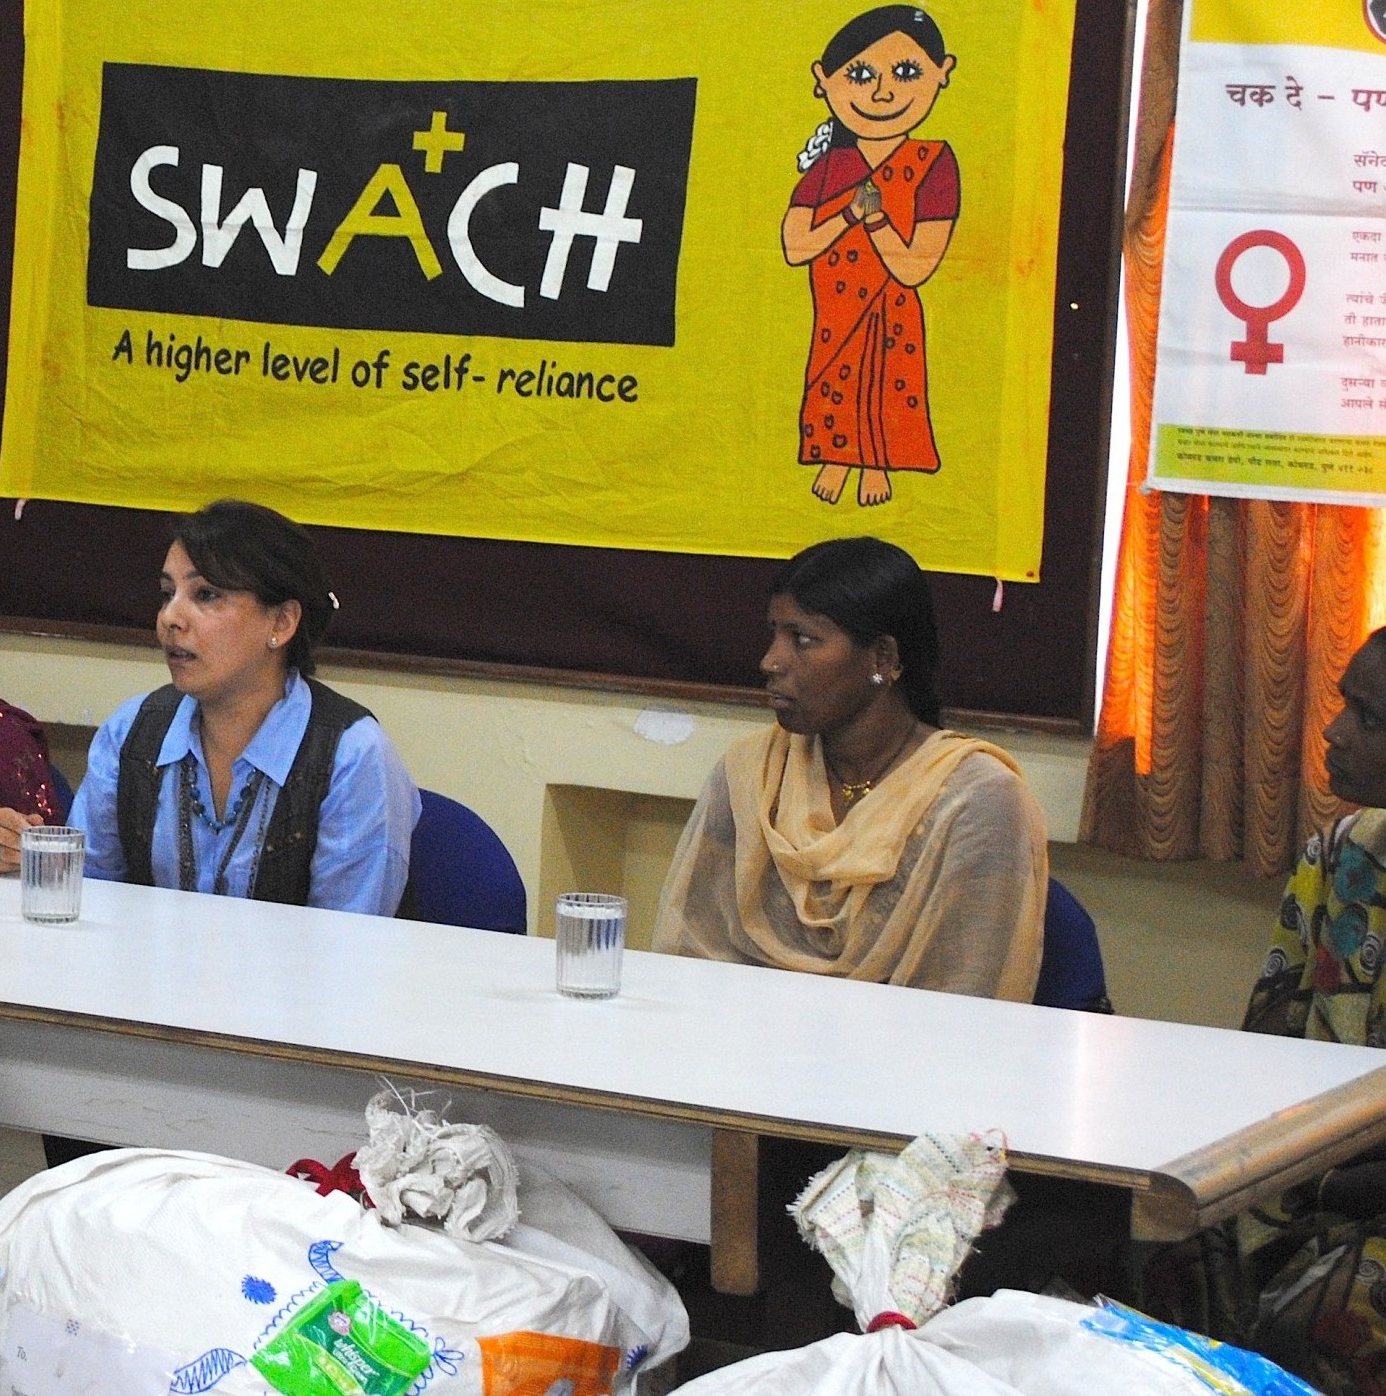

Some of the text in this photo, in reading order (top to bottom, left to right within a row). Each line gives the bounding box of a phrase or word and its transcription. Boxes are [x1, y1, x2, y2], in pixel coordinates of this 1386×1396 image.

[1225, 84, 1276, 107] चक
[1285, 75, 1304, 111] दे
[112, 330, 133, 364] A
[147, 329, 251, 383] higher
[262, 341, 340, 384] level
[351, 350, 390, 388] of
[497, 360, 639, 402] reliance
[333, 1338, 380, 1377] whisper
